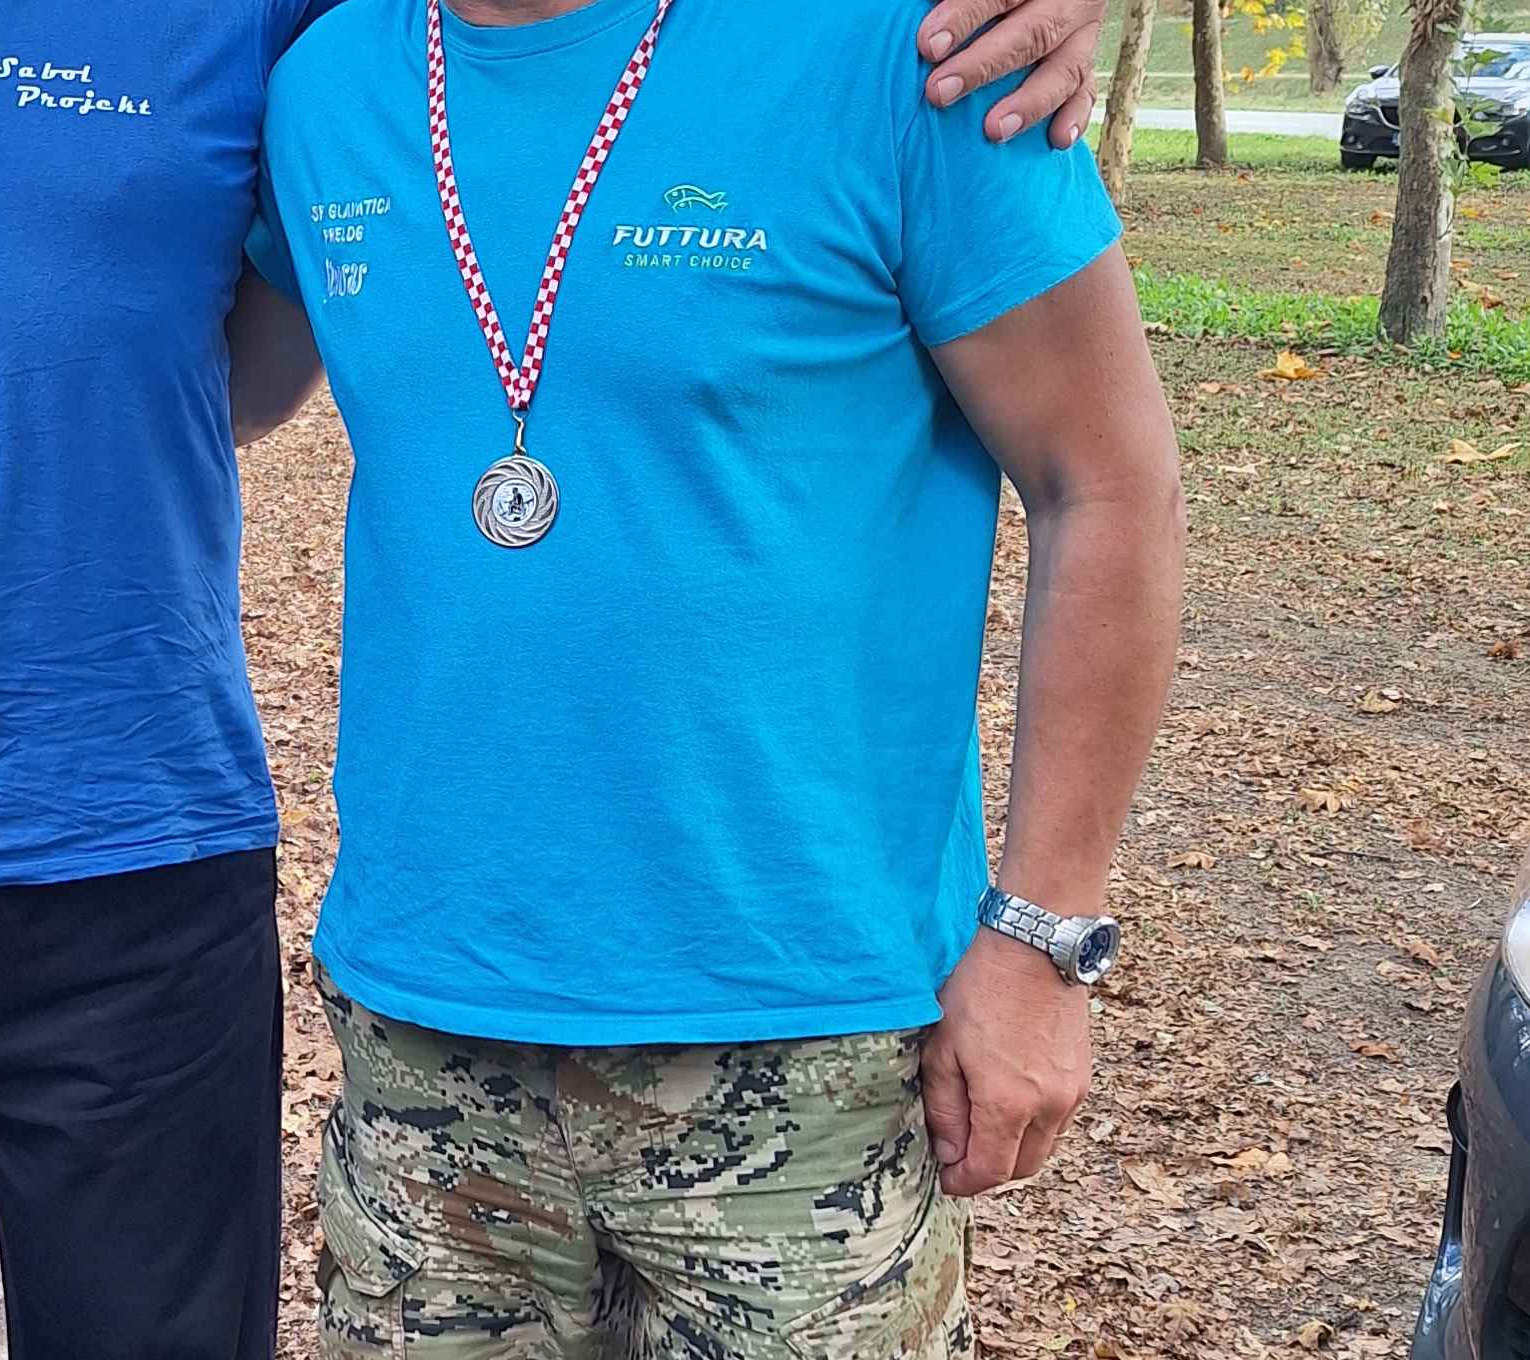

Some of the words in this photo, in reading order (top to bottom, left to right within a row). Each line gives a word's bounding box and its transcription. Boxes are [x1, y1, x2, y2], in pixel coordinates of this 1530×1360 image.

[16, 85, 153, 115] Projekt
[613, 225, 768, 250] FUTTURA
[624, 254, 682, 268] SMART
[690, 255, 753, 270] CHOICE
